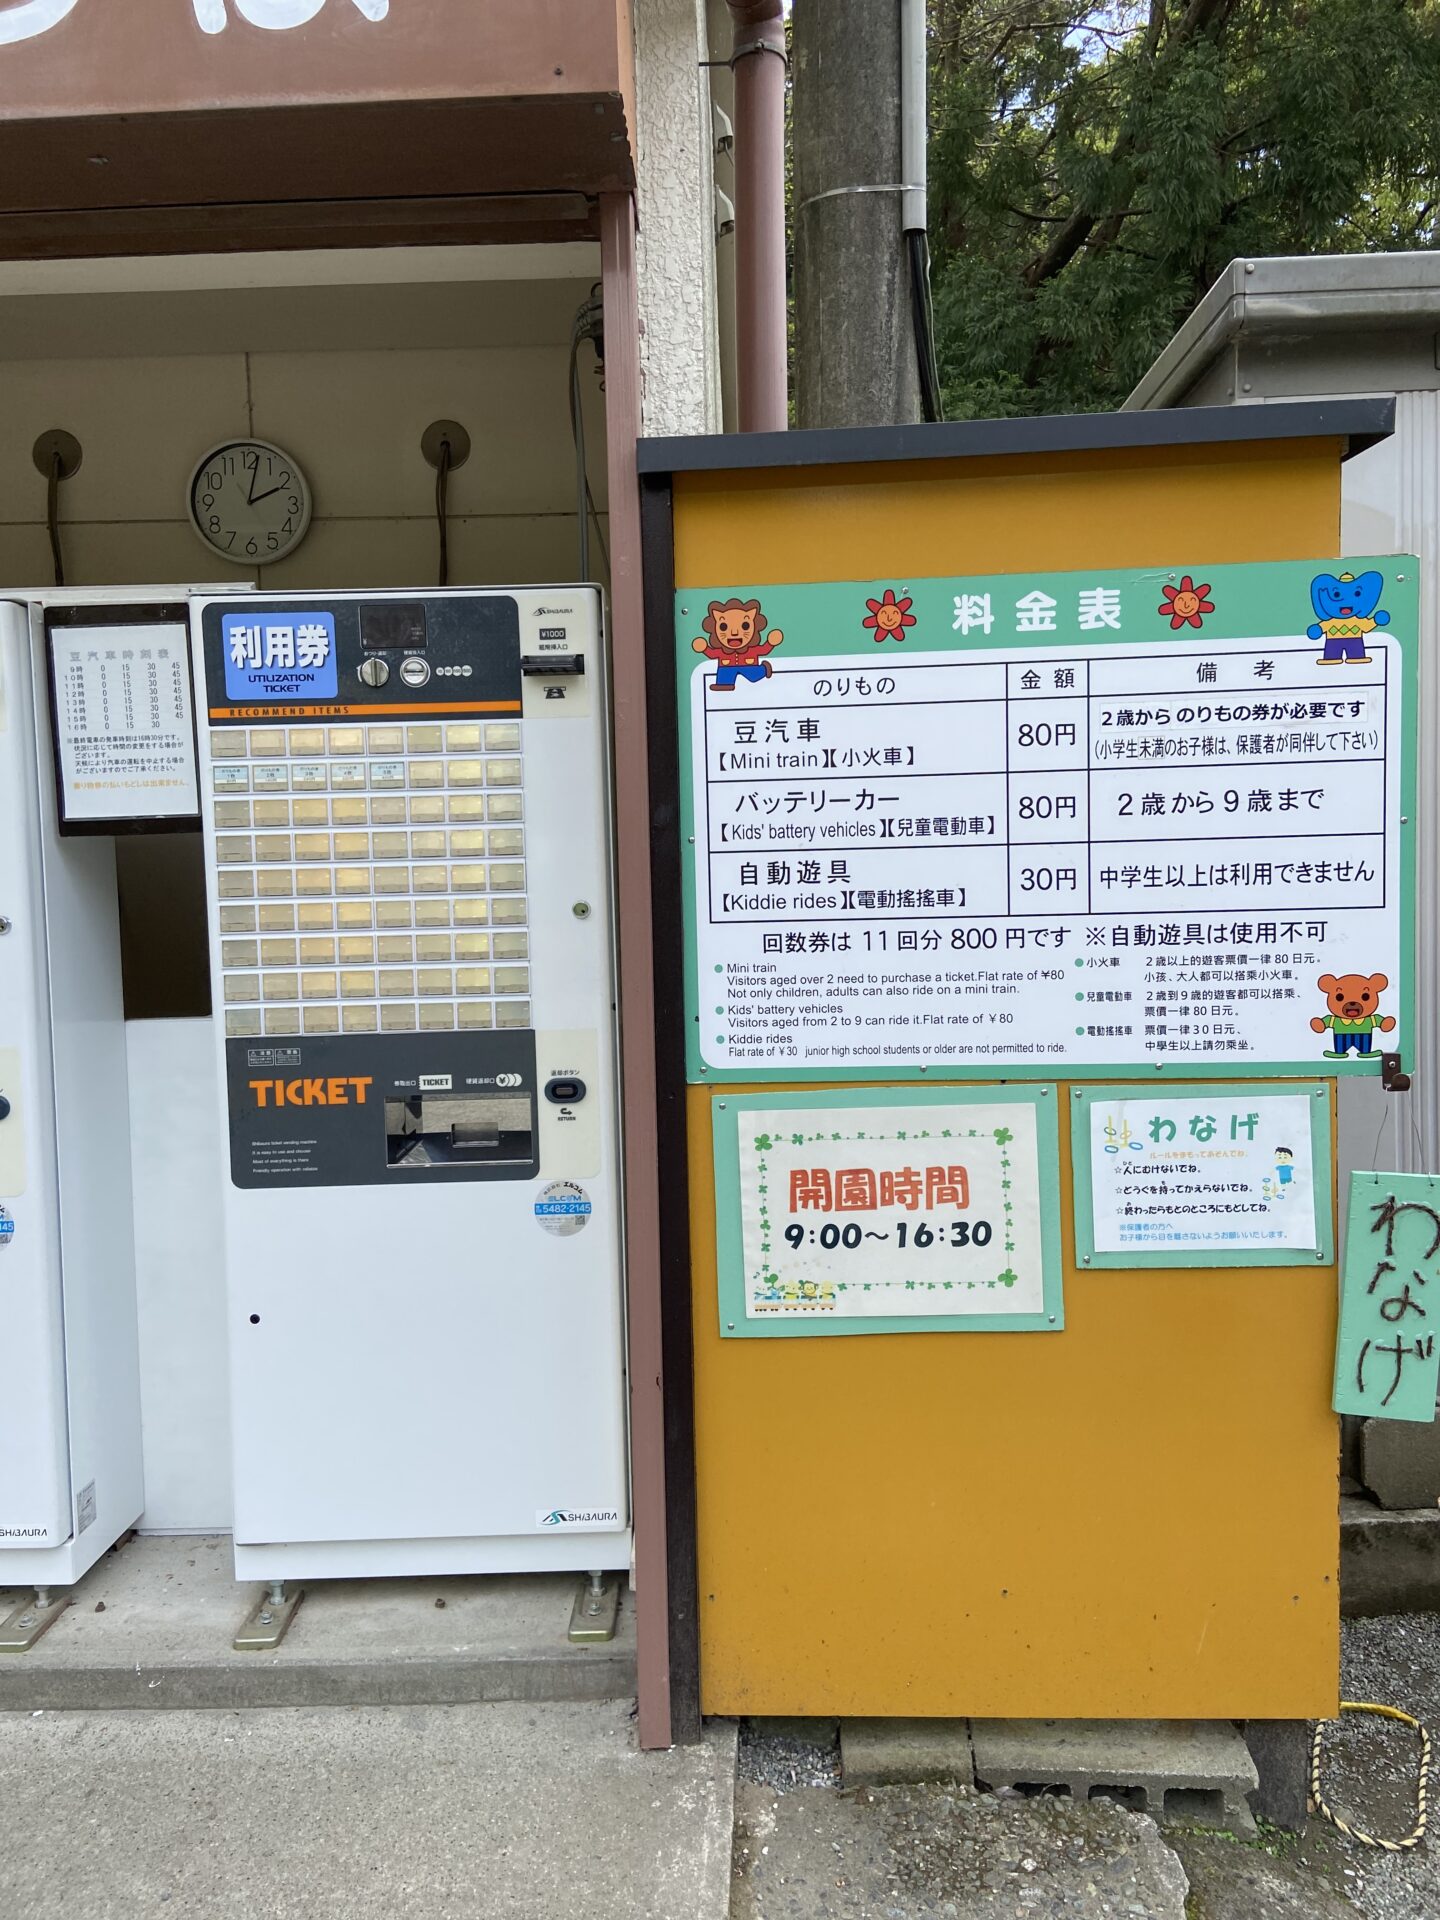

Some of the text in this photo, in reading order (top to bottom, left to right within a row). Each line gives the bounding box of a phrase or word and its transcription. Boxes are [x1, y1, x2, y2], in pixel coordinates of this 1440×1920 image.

[222, 457, 234, 476] 11
[241, 451, 258, 470] 12
[267, 458, 272, 476] 1
[204, 472, 222, 490] 10
[279, 471, 290, 489] 2
[202, 494, 214, 512] 9
[288, 496, 298, 514] 3
[209, 515, 221, 533] 8
[281, 517, 293, 535] 4
[225, 531, 236, 549] 7
[246, 536, 257, 554] 6
[267, 532, 278, 549] 5
[952, 588, 1121, 635] 料金表
[229, 624, 330, 669] 利用券
[100, 664, 106, 672] 0
[147, 662, 156, 670] 30
[172, 662, 180, 670] 45
[101, 672, 106, 680] 0
[148, 671, 156, 679] 30
[172, 670, 181, 678] 45
[248, 673, 315, 683] UTILIZATION
[813, 660, 1275, 697] のりもの 金額 備考
[263, 685, 300, 693] TICKET
[230, 706, 349, 716] RECOMMEND ITEMS
[105, 722, 110, 730] 0
[734, 718, 821, 744] 豆汽車
[1018, 723, 1076, 747] 80円
[735, 789, 899, 814] バッテリーカー
[1019, 795, 1076, 819] 80円
[769, 822, 816, 841] battery
[740, 860, 851, 886] 自動遊具
[1020, 868, 1076, 891] 30円
[1100, 861, 1374, 889] 中学生以上は利用できません
[727, 962, 776, 973] Mini train
[1086, 957, 1120, 968] 小火車
[726, 969, 1064, 988] Visitors aged over 2 need to purchase a ticket.Flat rate of ¥80
[727, 983, 1019, 1000] Not only children, adults can also ride on a mini train.
[728, 1003, 843, 1016] Kids' battery vehicles
[728, 1013, 1013, 1029] Visitors aged from 2 to 9 can ride it.Flat rate of ¥80
[728, 1033, 792, 1044] Kiddie rides
[728, 1046, 745, 1056] Flat
[747, 1047, 764, 1056] rate
[766, 1046, 775, 1056] of
[804, 1045, 829, 1058] junior
[831, 1045, 850, 1057] high
[852, 1044, 880, 1055] school
[883, 1044, 920, 1054] students
[922, 1046, 932, 1054] or
[934, 1043, 956, 1054] older
[958, 1045, 973, 1053] are
[975, 1044, 990, 1053] not
[992, 1042, 1033, 1055] permitted
[1036, 1043, 1045, 1052] to
[1047, 1042, 1066, 1052] ride.
[249, 1077, 373, 1107] TICKET
[1149, 1113, 1259, 1143] わなげ
[789, 1166, 970, 1213] 開園時間
[1357, 1196, 1440, 1406] わなげ
[568, 1513, 618, 1522] SHIBAURA
